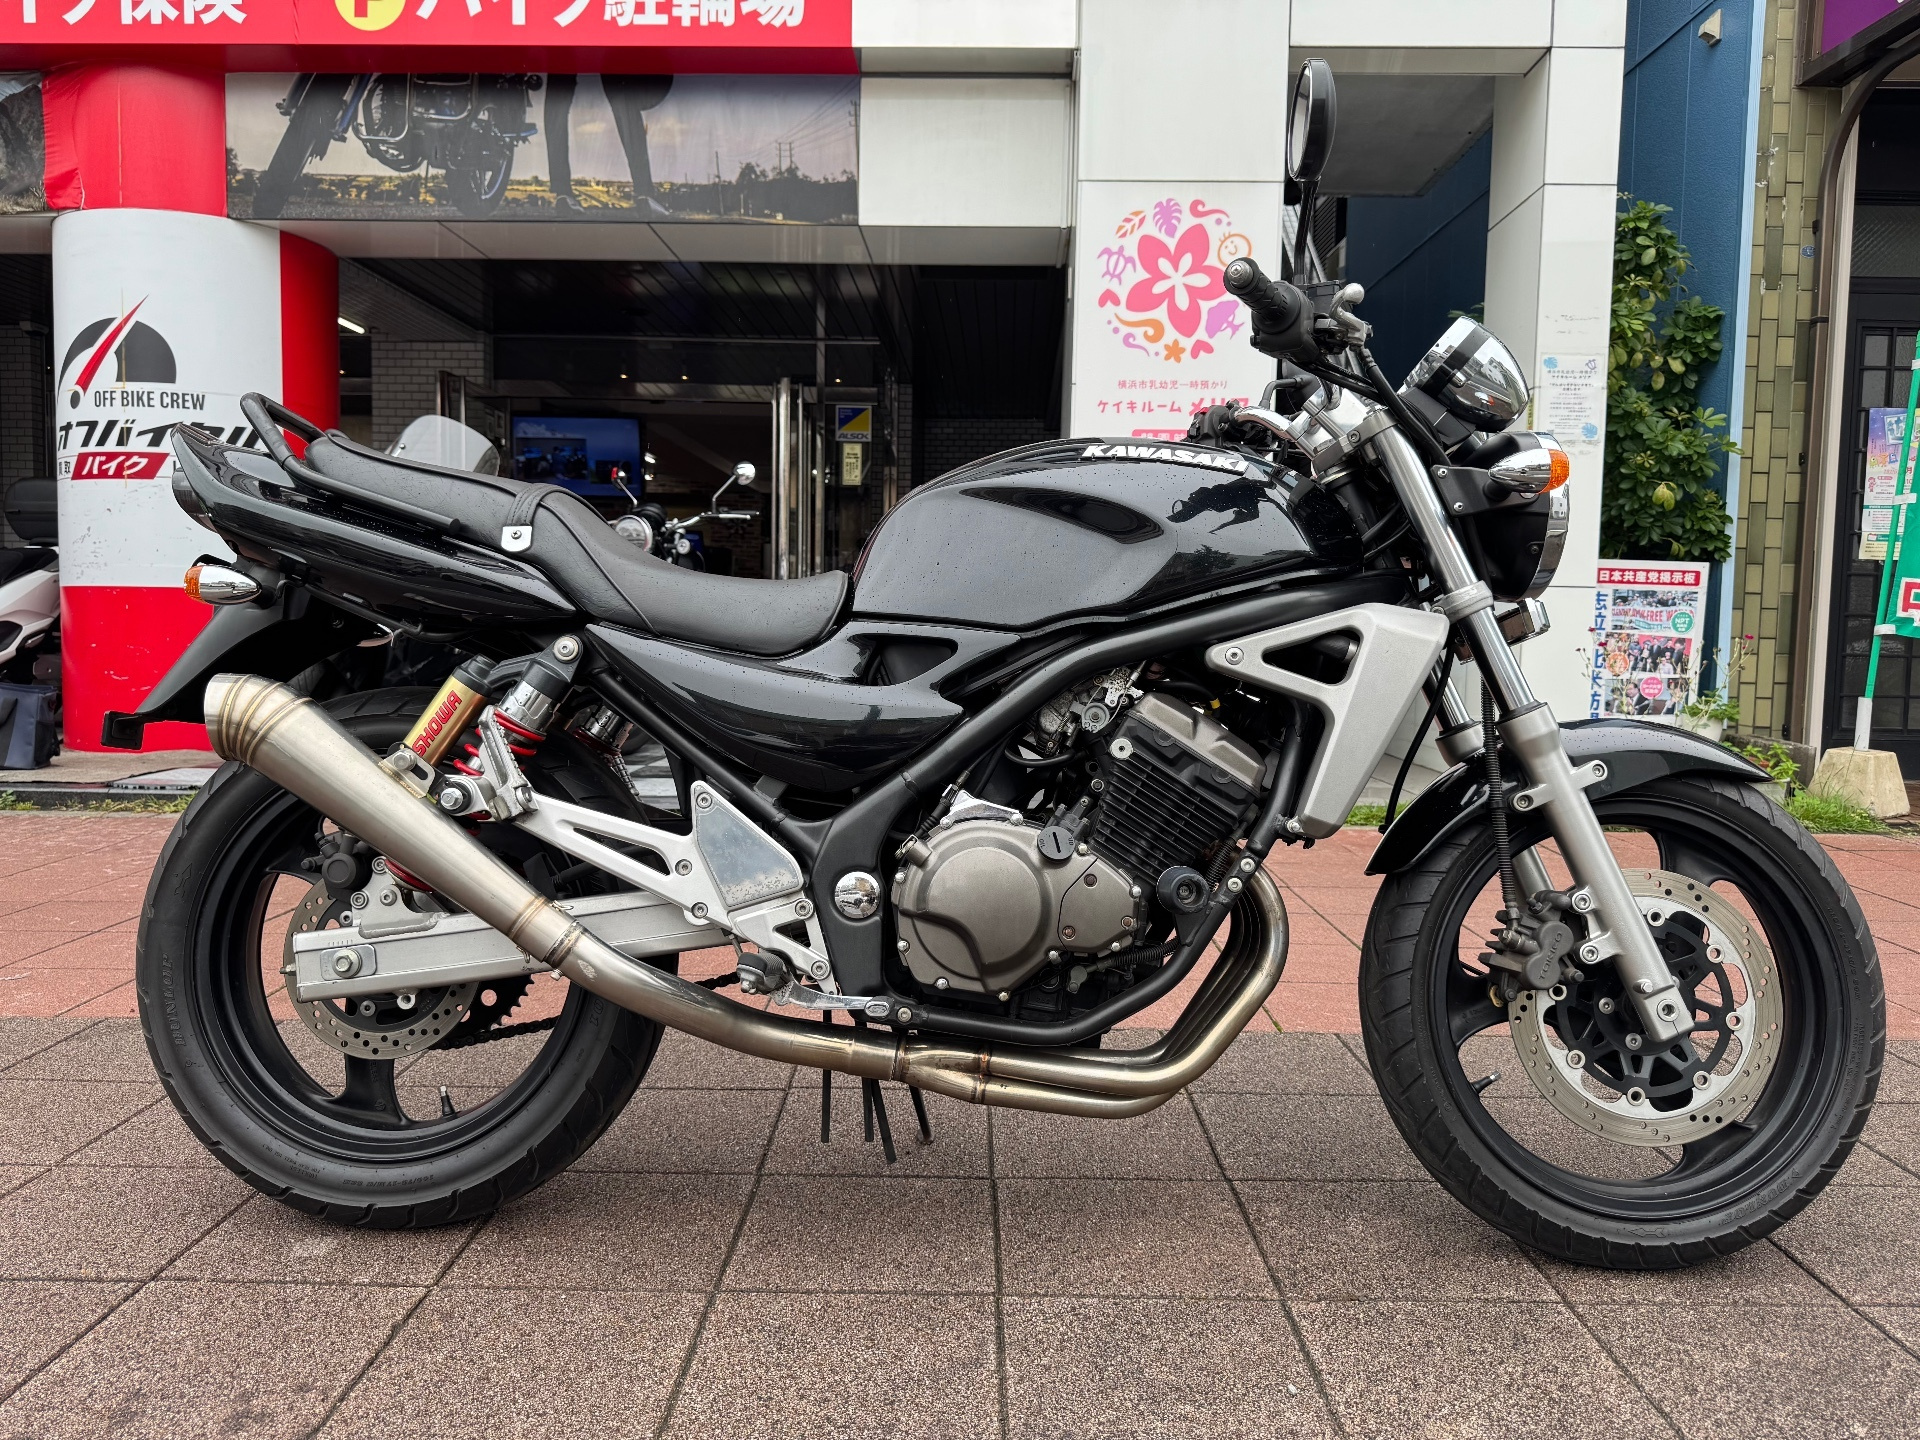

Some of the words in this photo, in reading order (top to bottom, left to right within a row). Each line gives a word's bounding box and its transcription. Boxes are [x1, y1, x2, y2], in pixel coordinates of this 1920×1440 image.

[1117, 379, 1228, 390] 横浜市乳幼児一時預かり
[94, 391, 117, 408] OFF
[121, 390, 155, 409] BIKE
[160, 392, 206, 411] CREW
[1097, 399, 1182, 414] ケイキルーム
[837, 432, 869, 440] ALSOK
[81, 455, 149, 476] バイク
[1081, 444, 1250, 474] KAWASAKI
[1598, 570, 1697, 585] 日本共産党掲示板
[411, 690, 463, 758] SHOWA
[161, 951, 188, 1048] DUNLOP
